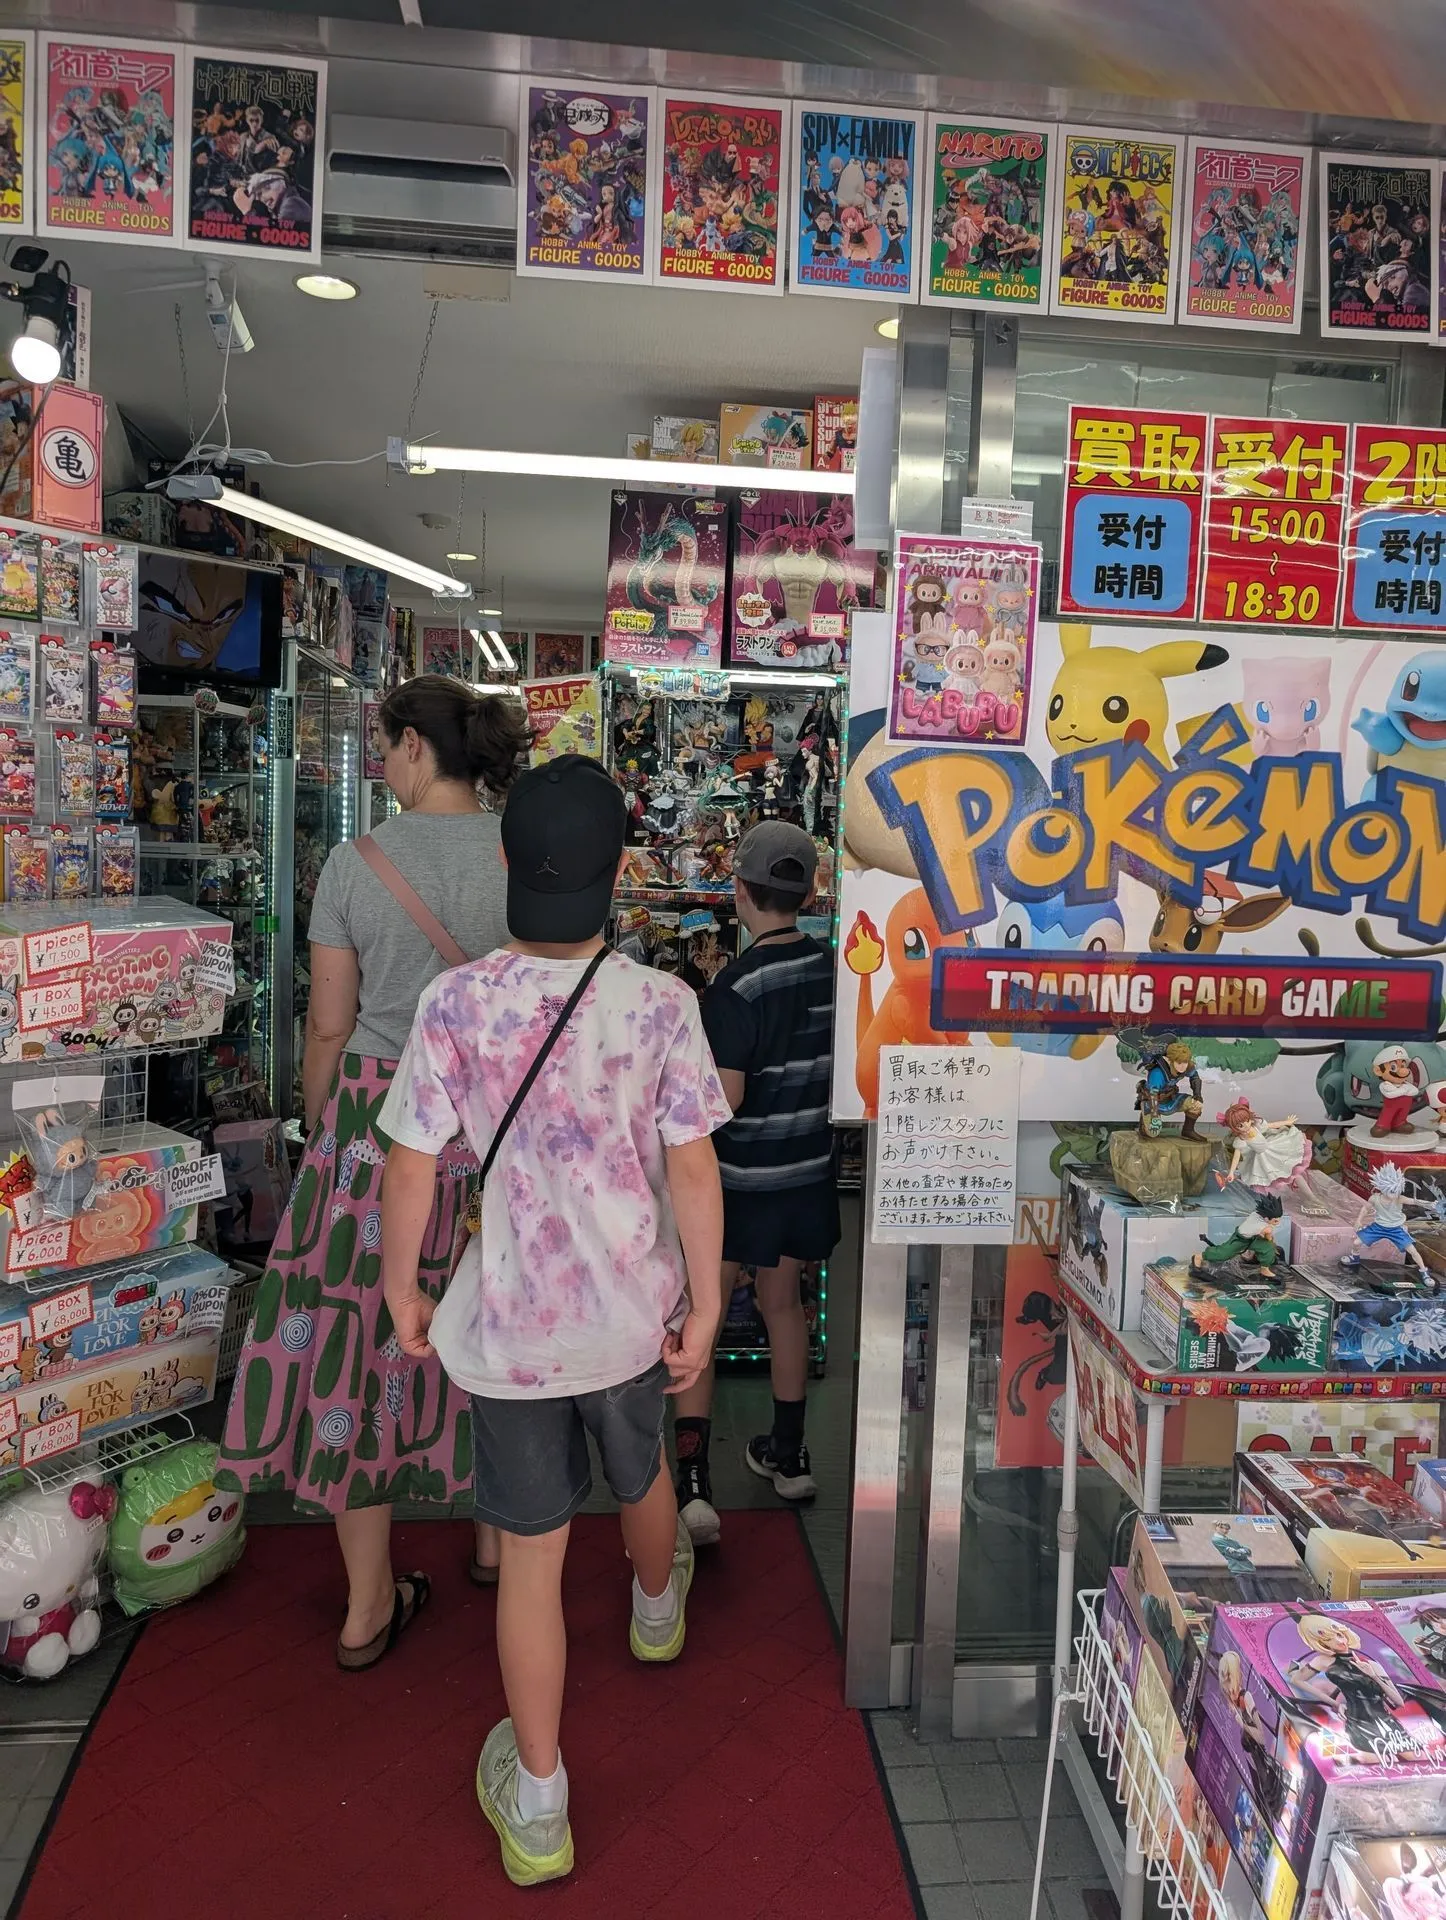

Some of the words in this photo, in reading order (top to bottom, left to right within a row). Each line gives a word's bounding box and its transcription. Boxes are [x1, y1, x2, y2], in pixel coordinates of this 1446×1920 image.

[53, 47, 171, 94] 初音ミク
[669, 111, 741, 144] DRAGON
[744, 114, 779, 147] BALL
[939, 130, 1043, 161] NARUTO
[1197, 151, 1300, 195] 初音ミク
[51, 207, 105, 225] FIGURE
[120, 213, 170, 230] GOODS
[203, 211, 233, 221] HOBBY
[192, 220, 246, 240] FIGURE
[260, 227, 309, 247] GOODS
[541, 238, 568, 247] HOBBY
[578, 242, 602, 250] ANIME
[530, 247, 580, 264] FIGURE
[595, 253, 641, 269] GOODS
[675, 248, 702, 257] HOBBY
[712, 252, 736, 262] ANIME
[745, 254, 760, 263] TOY
[813, 256, 839, 267] HOBBY
[847, 260, 871, 270] ANIME
[880, 263, 895, 271] TOY
[664, 258, 714, 275] FIGURE
[728, 264, 773, 280] GOODS
[802, 265, 851, 283] FIGURE
[864, 272, 908, 288] GOODS
[944, 269, 969, 278] HOBBY
[978, 271, 1002, 281] ANIME
[1010, 274, 1025, 283] TOY
[933, 277, 981, 294] FIGURE
[994, 283, 1037, 299] GOODS
[1073, 279, 1099, 290] HOBBY
[1106, 281, 1130, 291] ANIME
[1138, 284, 1153, 293] TOY
[1202, 289, 1226, 298] HOBBY
[1235, 292, 1257, 301] ANIME
[1266, 293, 1279, 302] TOY
[1062, 287, 1109, 305] FIGURE
[1122, 293, 1165, 310] GOODS
[1191, 298, 1237, 314] FIGURE
[1250, 303, 1292, 319] GOODS
[1332, 311, 1376, 327] FIGURE
[1387, 313, 1429, 329] GOODS
[53, 436, 86, 481] 亀
[1073, 418, 1201, 491] 買取
[1215, 431, 1343, 501] 受付
[1097, 512, 1167, 550] 受付
[1230, 506, 1326, 546] 15:00
[1379, 529, 1446, 565] 受付
[910, 564, 1004, 582] ARRIVAL!!
[1094, 563, 1163, 600] 時間
[1224, 581, 1320, 622] 18:30
[1374, 579, 1442, 615] 時間
[903, 688, 1018, 735] LABUBU
[34, 941, 41, 952] 1
[46, 933, 86, 952] piece
[36, 954, 44, 967] ¥
[32, 993, 38, 1004] 1
[45, 987, 73, 1000] BOX
[84, 979, 160, 1005] ACARON
[986, 970, 1154, 1016] TRADING
[1169, 974, 1266, 1018] CARD
[1281, 980, 1389, 1020] GAME
[29, 1008, 37, 1022] ¥
[43, 1003, 79, 1018] 45,000
[889, 1055, 991, 1082] 買取ご希望の
[884, 1115, 1004, 1134] 1階レジスタッフに
[882, 1139, 1001, 1163] お声がけ下さい。
[167, 1156, 218, 1184] 10%OFF
[171, 1171, 212, 1193] COUPON
[879, 1194, 998, 1208] お待たせする場合が
[879, 1211, 1015, 1226] ございます。予めご了承下さい。
[17, 1238, 24, 1248] 1
[26, 1231, 63, 1248] piece
[16, 1250, 24, 1263] ¥
[57, 1294, 81, 1311] BOX
[41, 1320, 48, 1333] ¥
[54, 1307, 87, 1328] 68,000
[93, 1308, 120, 1324] PIN
[97, 1319, 136, 1339] FOR
[84, 1334, 128, 1356] LOVE
[1189, 1340, 1200, 1369] SERIES
[1206, 1331, 1217, 1368] CHIMERA
[1198, 1352, 1207, 1368] ANT
[87, 1376, 116, 1398] PIN
[1219, 1381, 1268, 1395] FIGURE
[1270, 1382, 1309, 1395] SHOP
[1311, 1381, 1373, 1395] MARURU
[91, 1391, 127, 1411] FOR
[50, 1419, 74, 1437] BOX
[30, 1444, 38, 1457] ¥
